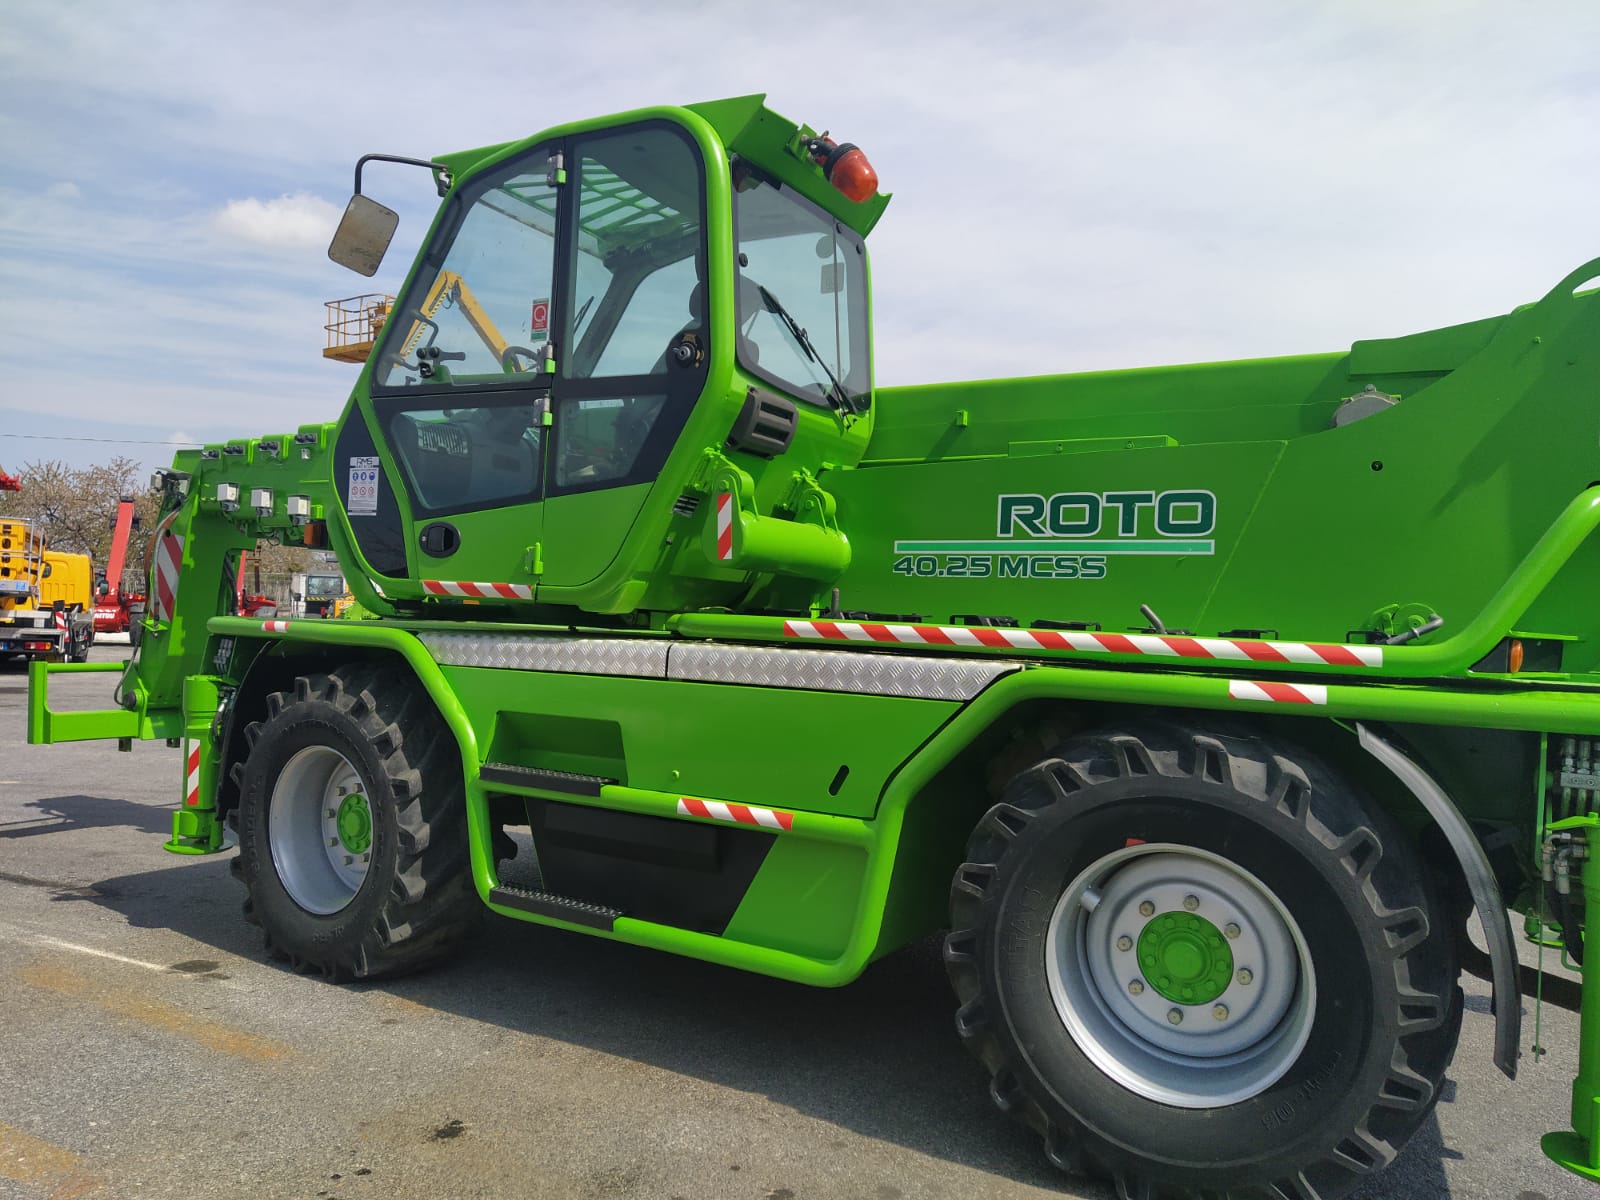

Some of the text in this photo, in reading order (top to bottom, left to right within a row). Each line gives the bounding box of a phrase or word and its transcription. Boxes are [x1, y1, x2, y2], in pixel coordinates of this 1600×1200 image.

[997, 489, 1216, 537] ROTO
[893, 555, 1107, 579] 40.25 MCSS
